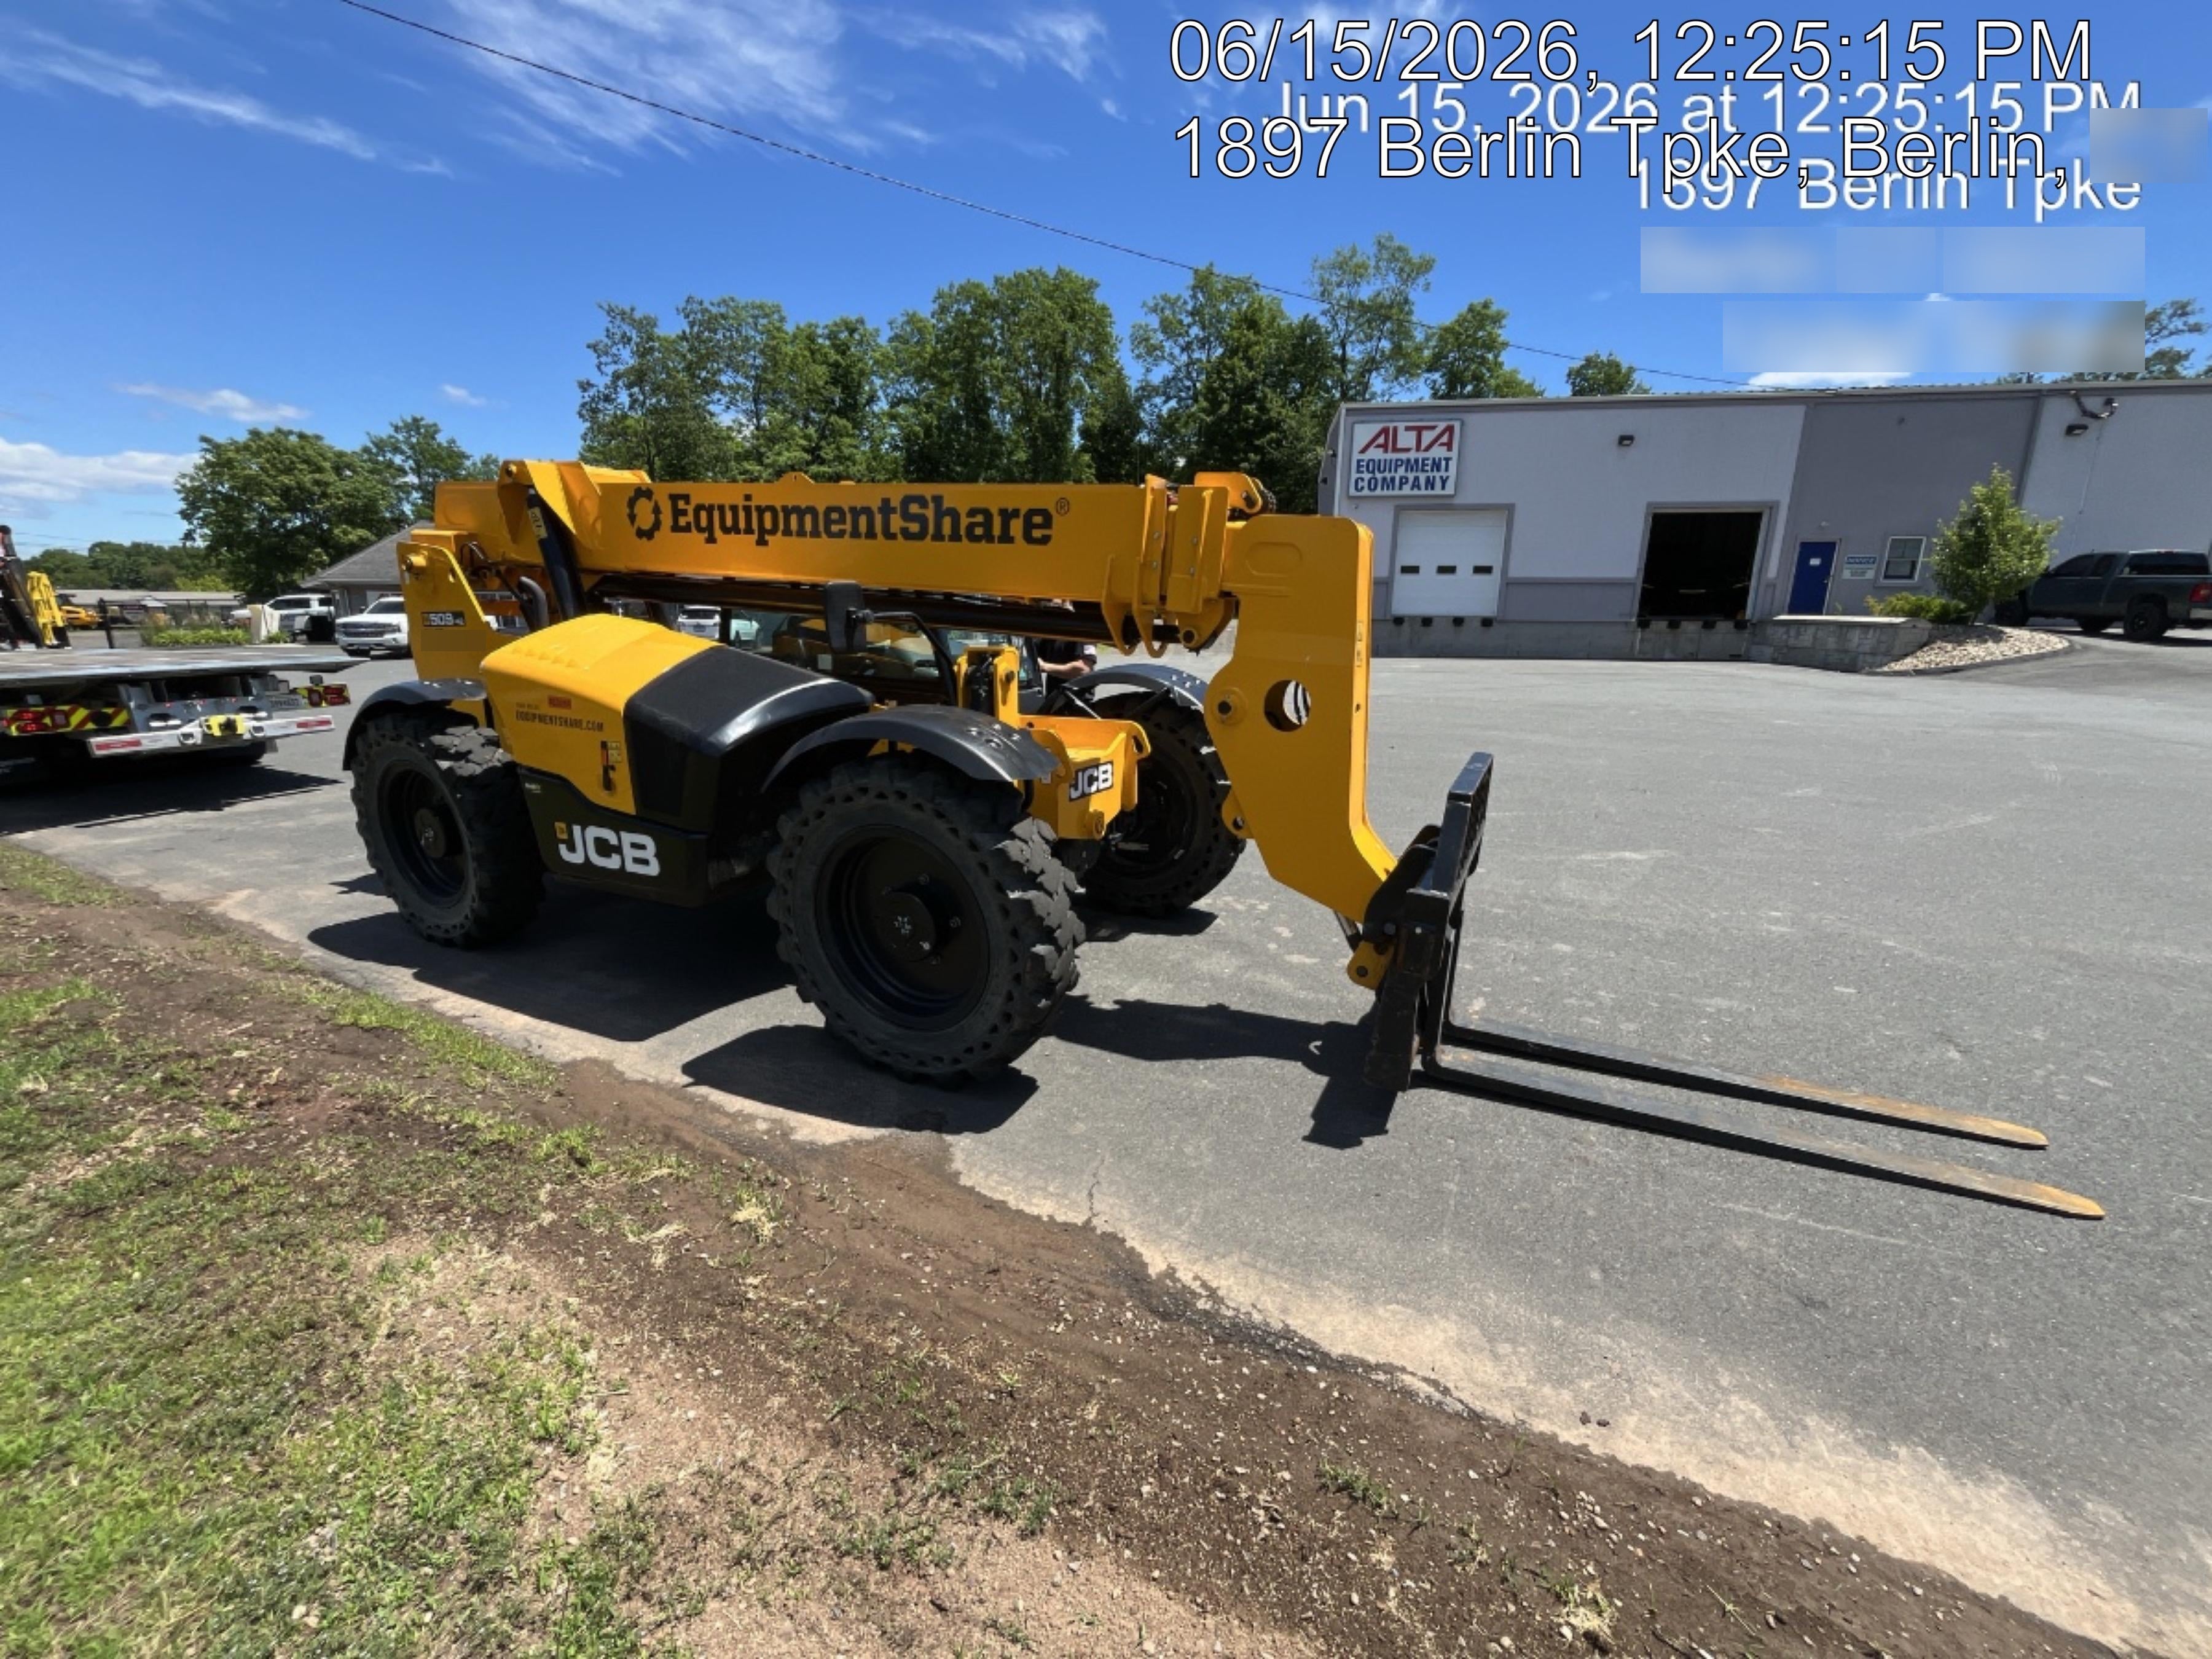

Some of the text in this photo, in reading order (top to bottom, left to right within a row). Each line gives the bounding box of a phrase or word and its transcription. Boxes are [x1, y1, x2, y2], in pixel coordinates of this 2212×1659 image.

[1358, 424, 1455, 453] ALTA
[1355, 457, 1453, 476] EQUIPMENT
[1354, 475, 1450, 493] COMPANY
[1070, 763, 1113, 799] JCB
[558, 825, 661, 876] JCB
